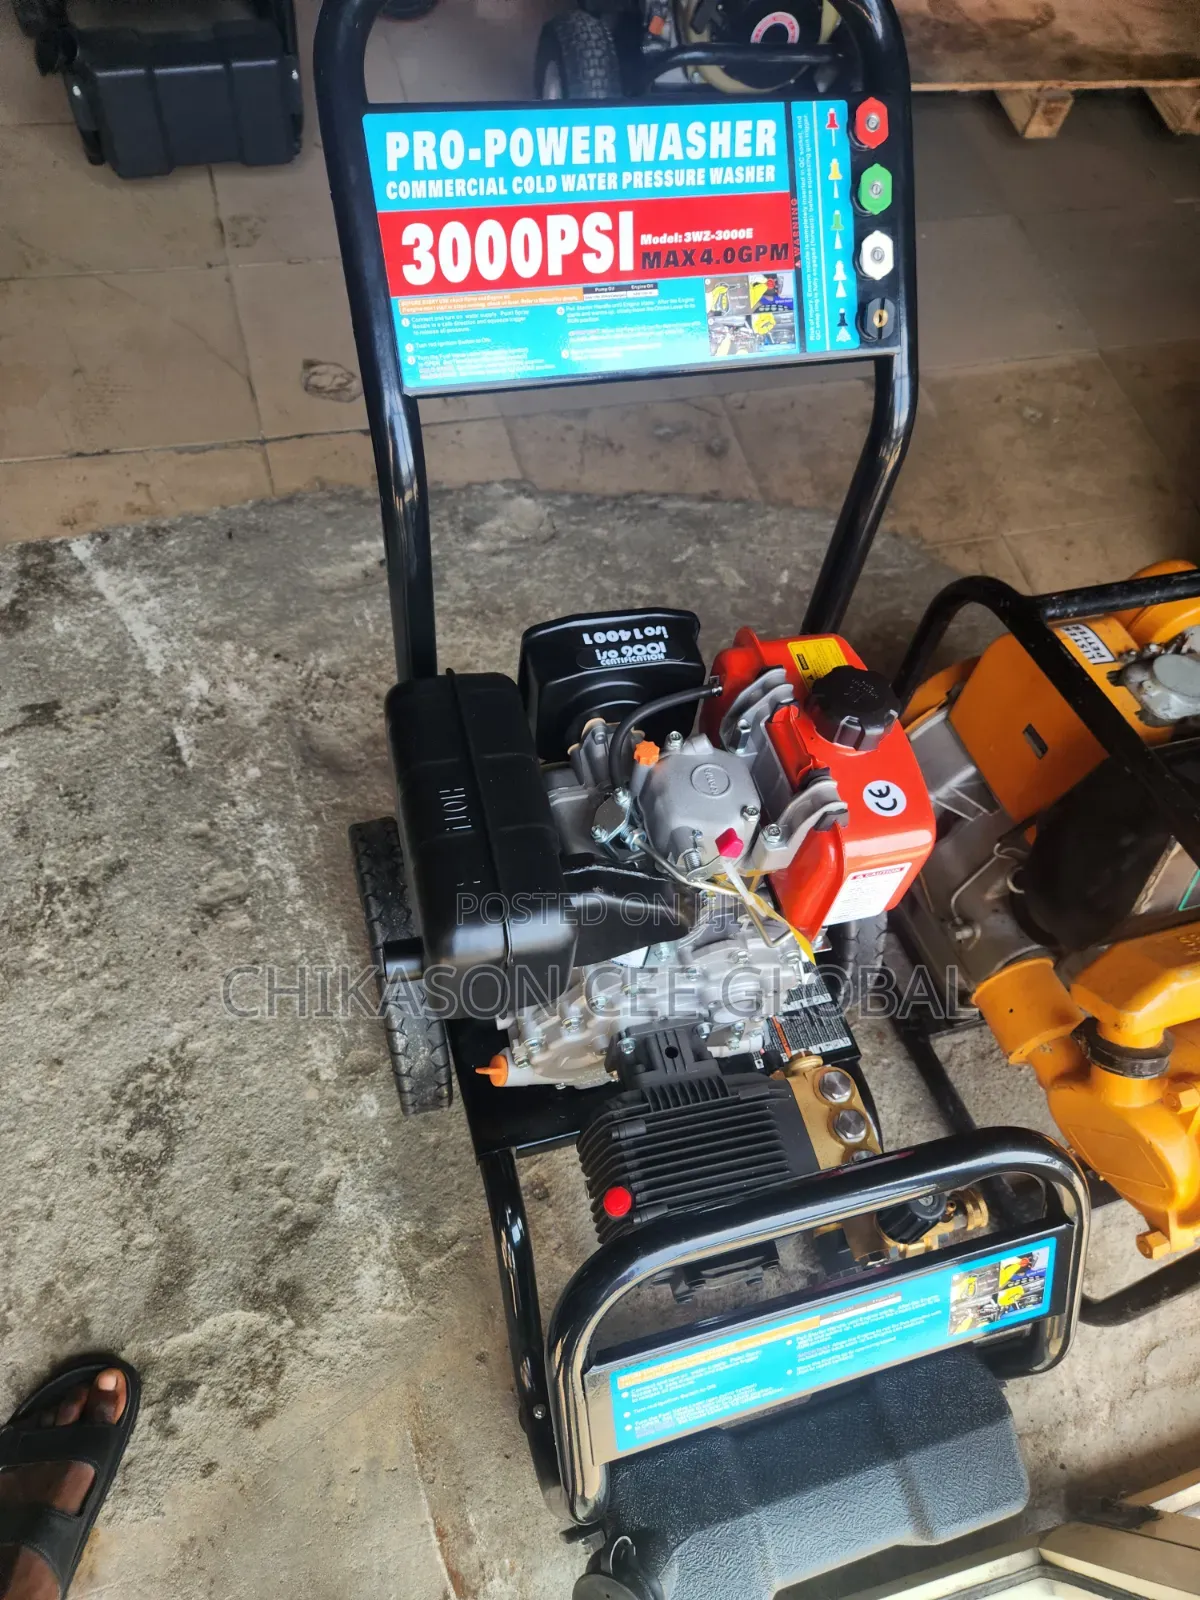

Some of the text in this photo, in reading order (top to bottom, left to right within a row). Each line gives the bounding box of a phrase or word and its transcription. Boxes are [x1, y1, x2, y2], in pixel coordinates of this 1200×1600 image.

[385, 118, 777, 171] PRO-POWER WASHER
[386, 164, 776, 201] COMMERCIAL COLD WATER PRESSURE WASHER
[401, 209, 635, 286] 3000PSI
[640, 228, 753, 245] Model: 3WZ-3000E
[791, 198, 801, 257] WARNING
[641, 242, 790, 270] MAX 4.0GPM
